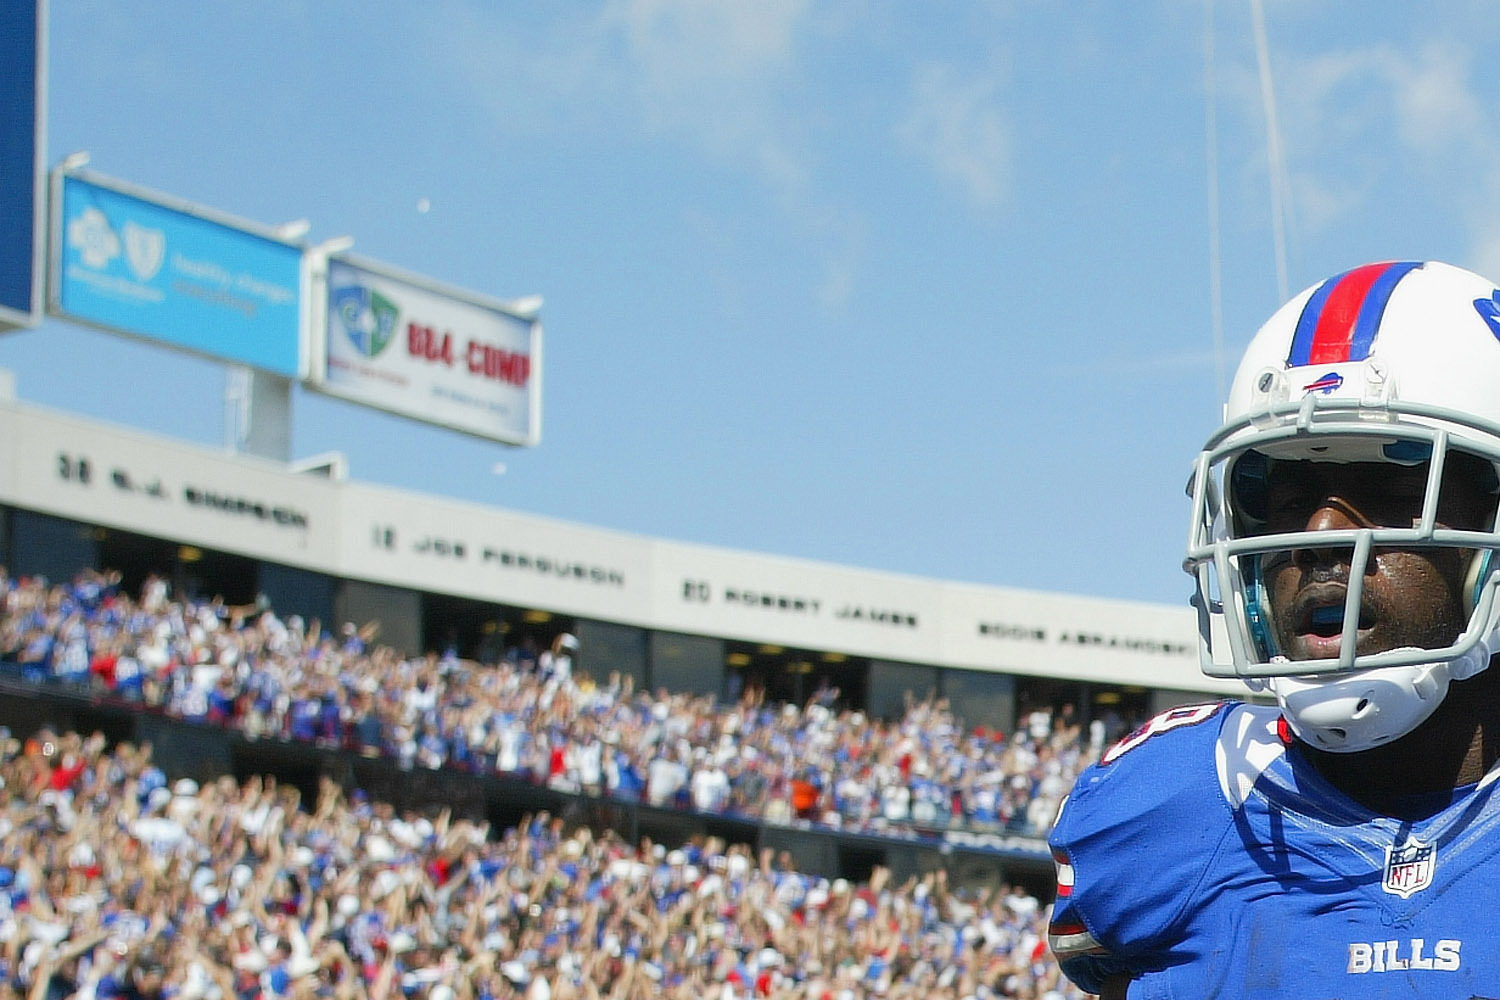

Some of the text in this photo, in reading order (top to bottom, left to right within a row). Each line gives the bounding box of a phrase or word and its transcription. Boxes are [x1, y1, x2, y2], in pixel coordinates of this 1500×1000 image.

[412, 536, 469, 560] JOE
[481, 546, 627, 587] FERGUSON
[723, 588, 821, 613] ROBERT
[832, 606, 920, 629] JAMES
[1390, 863, 1424, 887] NFL
[1347, 938, 1462, 974] BILLS
